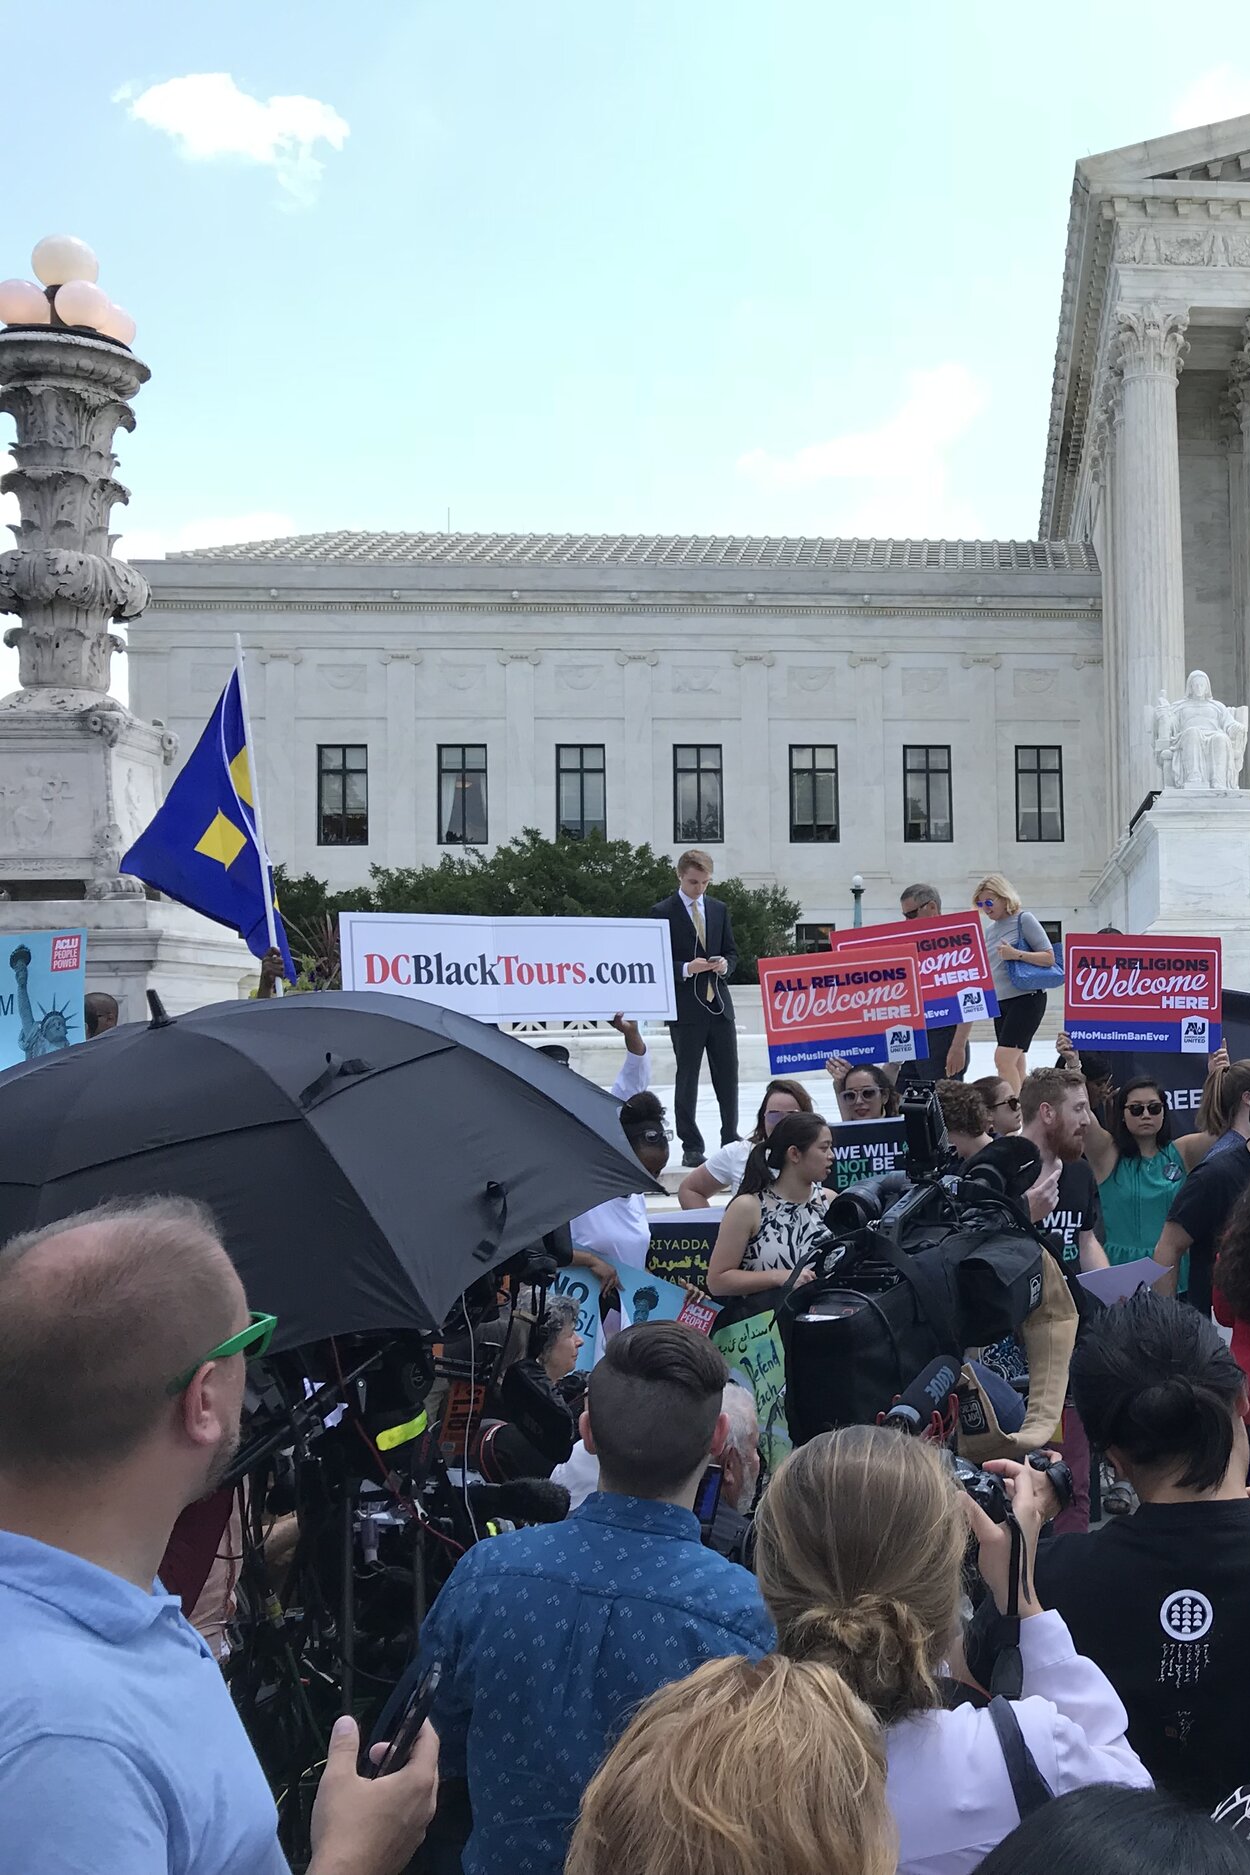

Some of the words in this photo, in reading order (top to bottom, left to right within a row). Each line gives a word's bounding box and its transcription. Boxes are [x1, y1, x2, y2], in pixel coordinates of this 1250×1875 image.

[55, 938, 79, 950] ACLU
[54, 948, 78, 960] PEOPLE
[53, 959, 77, 969] POWER
[364, 952, 656, 985] DCBlackTours.com
[1077, 957, 1111, 969] ALL
[1115, 957, 1210, 971] RELIGIONS
[774, 978, 808, 993] ALL
[811, 967, 907, 989] RELIGIONS
[934, 968, 980, 986] HERE
[1076, 962, 1208, 1001] Welcome
[774, 982, 908, 1025] Welcome
[1162, 995, 1209, 1010] HERE
[863, 1004, 912, 1022] HERE
[1070, 1030, 1170, 1042] #NoMuslimBanEver
[776, 1046, 875, 1064] #NoMuslimBanEver
[833, 1145, 861, 1160] WE
[863, 1142, 903, 1158] WILL
[837, 1158, 869, 1174] NOT
[872, 1156, 895, 1171] BE
[1043, 1211, 1082, 1228] WILL
[650, 1239, 710, 1250] RIYADDA
[680, 1313, 710, 1331] PEOPLE
[685, 1305, 713, 1321] ACLU
